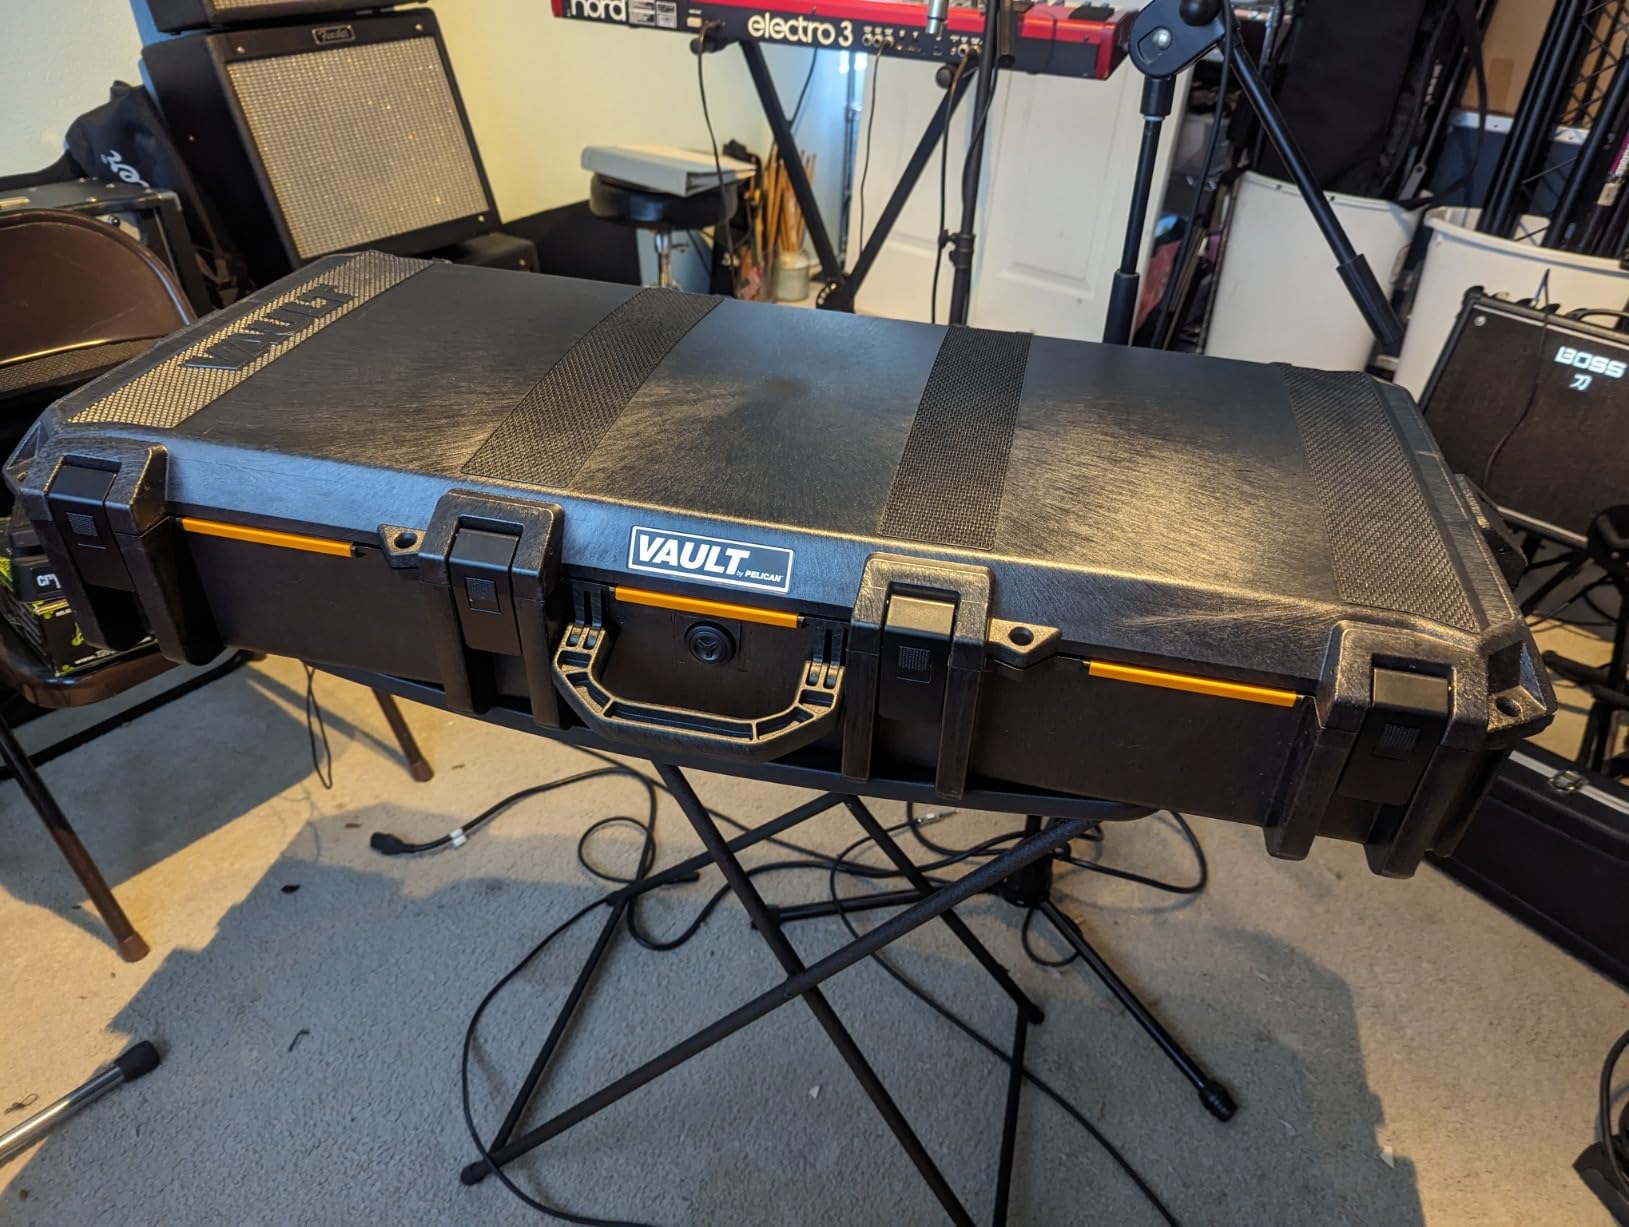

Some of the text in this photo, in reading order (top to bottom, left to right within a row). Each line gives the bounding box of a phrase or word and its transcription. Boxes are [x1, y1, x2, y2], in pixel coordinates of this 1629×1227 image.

[571, 0, 627, 22] nord
[747, 12, 854, 47] electro 3
[1554, 345, 1628, 379] BOSS
[639, 534, 750, 576] VAULT
[736, 569, 783, 583] by PELICAN
